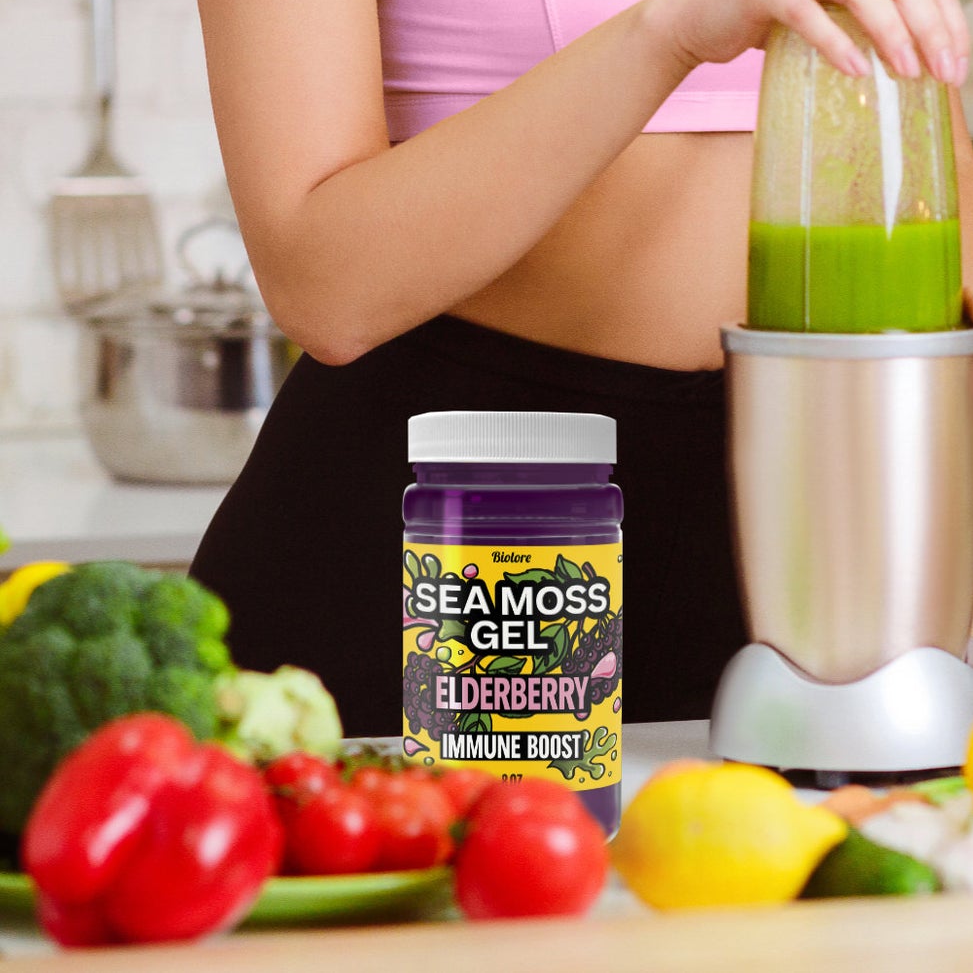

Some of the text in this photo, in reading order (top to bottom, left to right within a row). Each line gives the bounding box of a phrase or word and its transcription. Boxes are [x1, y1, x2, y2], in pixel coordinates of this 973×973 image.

[415, 582, 608, 616] SEA MOSS
[470, 620, 549, 650] GEL
[436, 675, 590, 711] ELDERBERRY
[442, 733, 581, 760] IMMUNE BOOST
